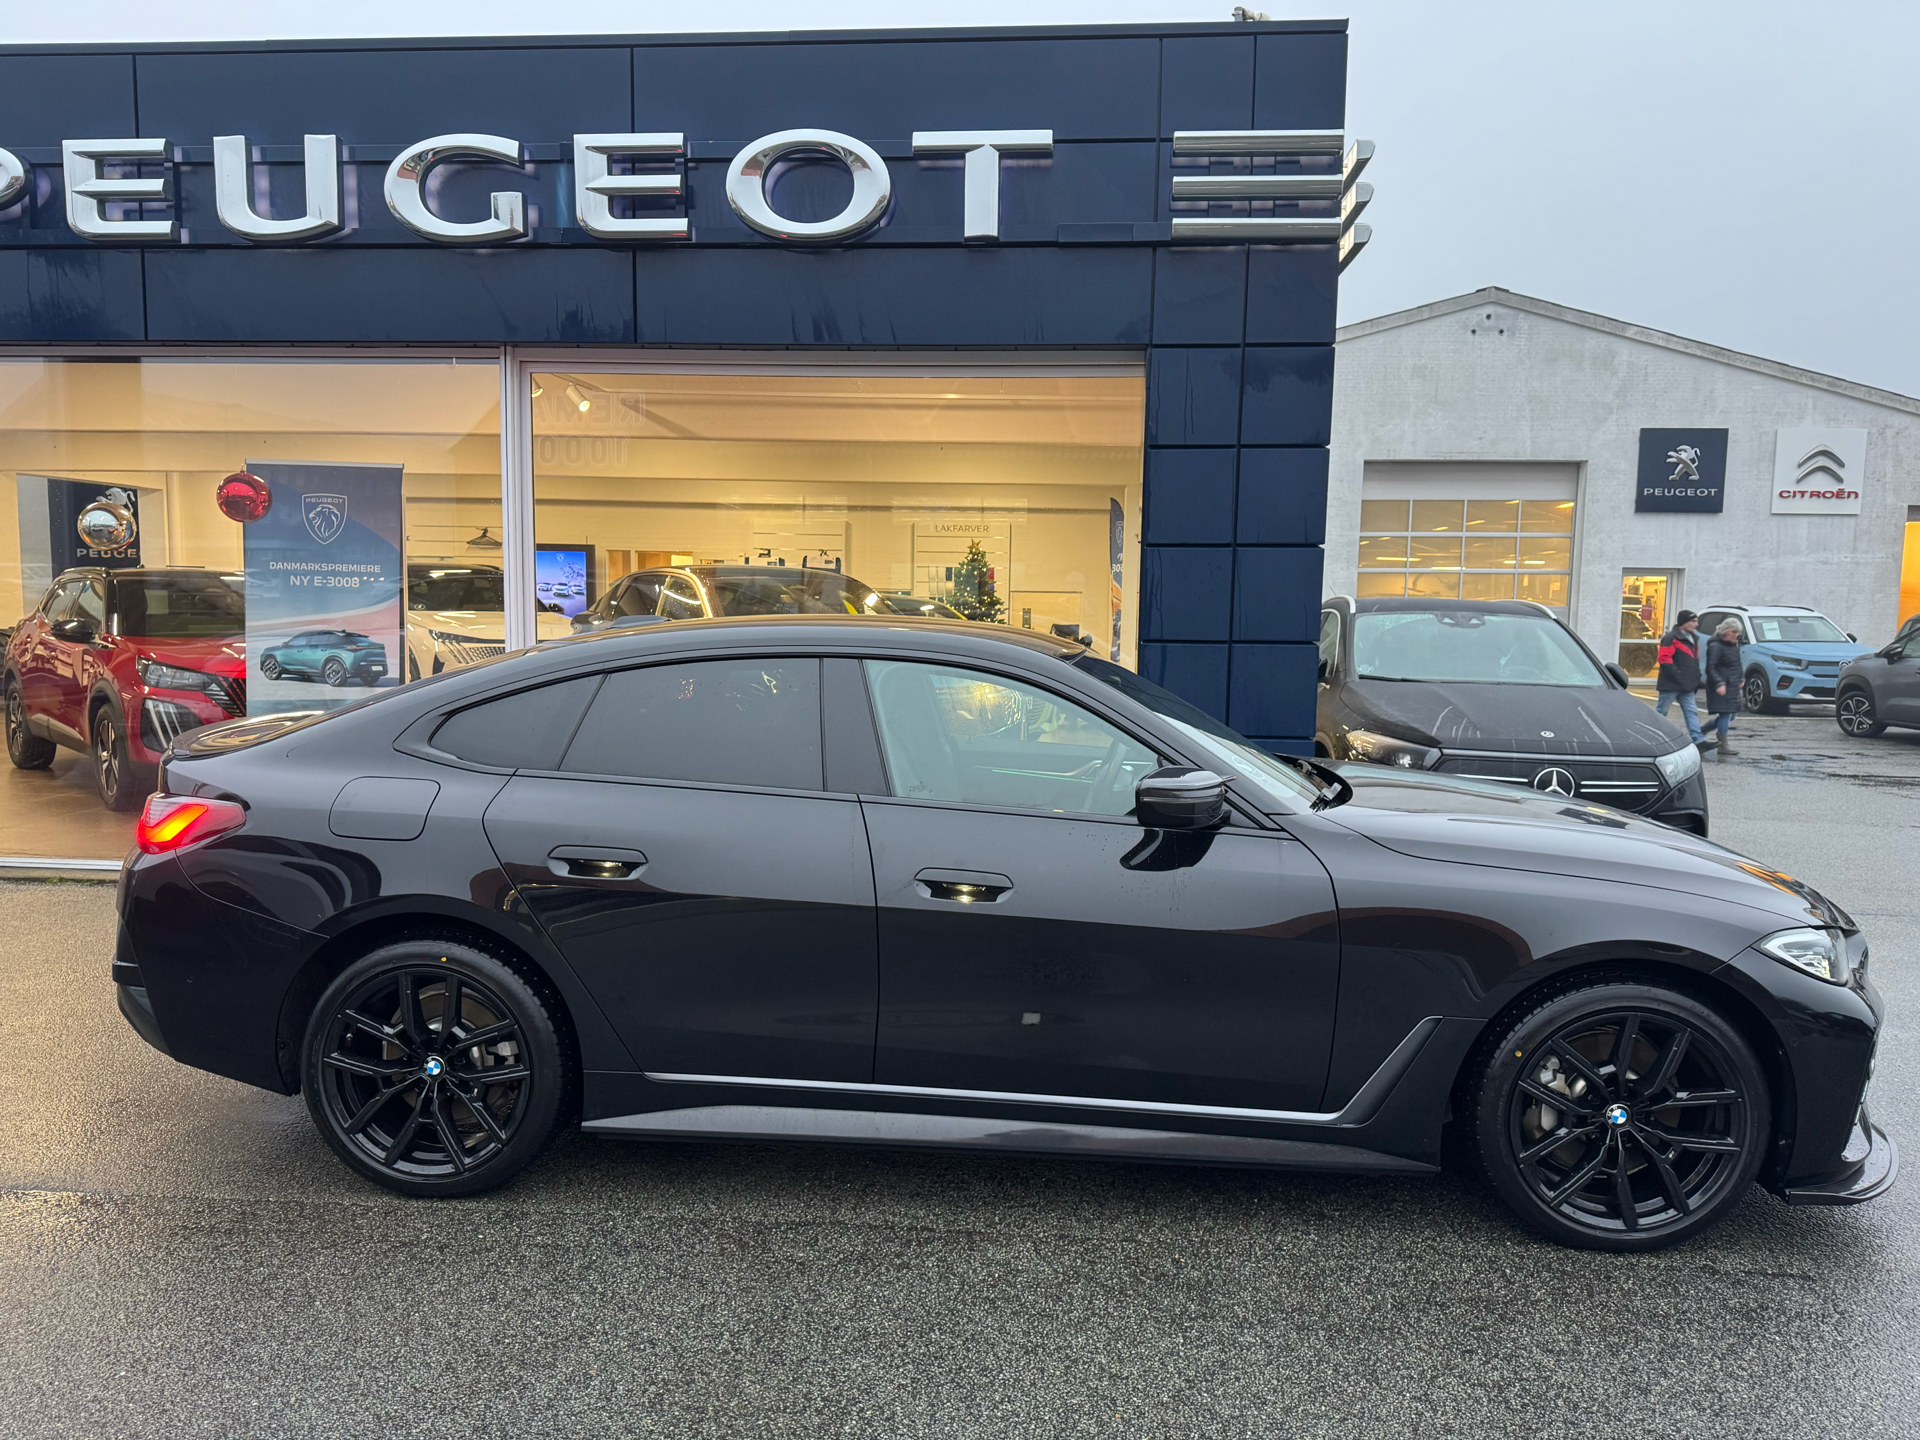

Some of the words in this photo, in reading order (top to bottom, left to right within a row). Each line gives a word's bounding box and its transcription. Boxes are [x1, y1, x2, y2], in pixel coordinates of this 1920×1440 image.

[1643, 488, 1718, 497] PEUGEOT
[1778, 488, 1859, 499] CITROËN
[935, 524, 989, 533] LAKFARVER
[269, 561, 381, 573] DANMARKSPREMIERE
[290, 575, 311, 586] NY
[313, 576, 360, 588] E-3008
